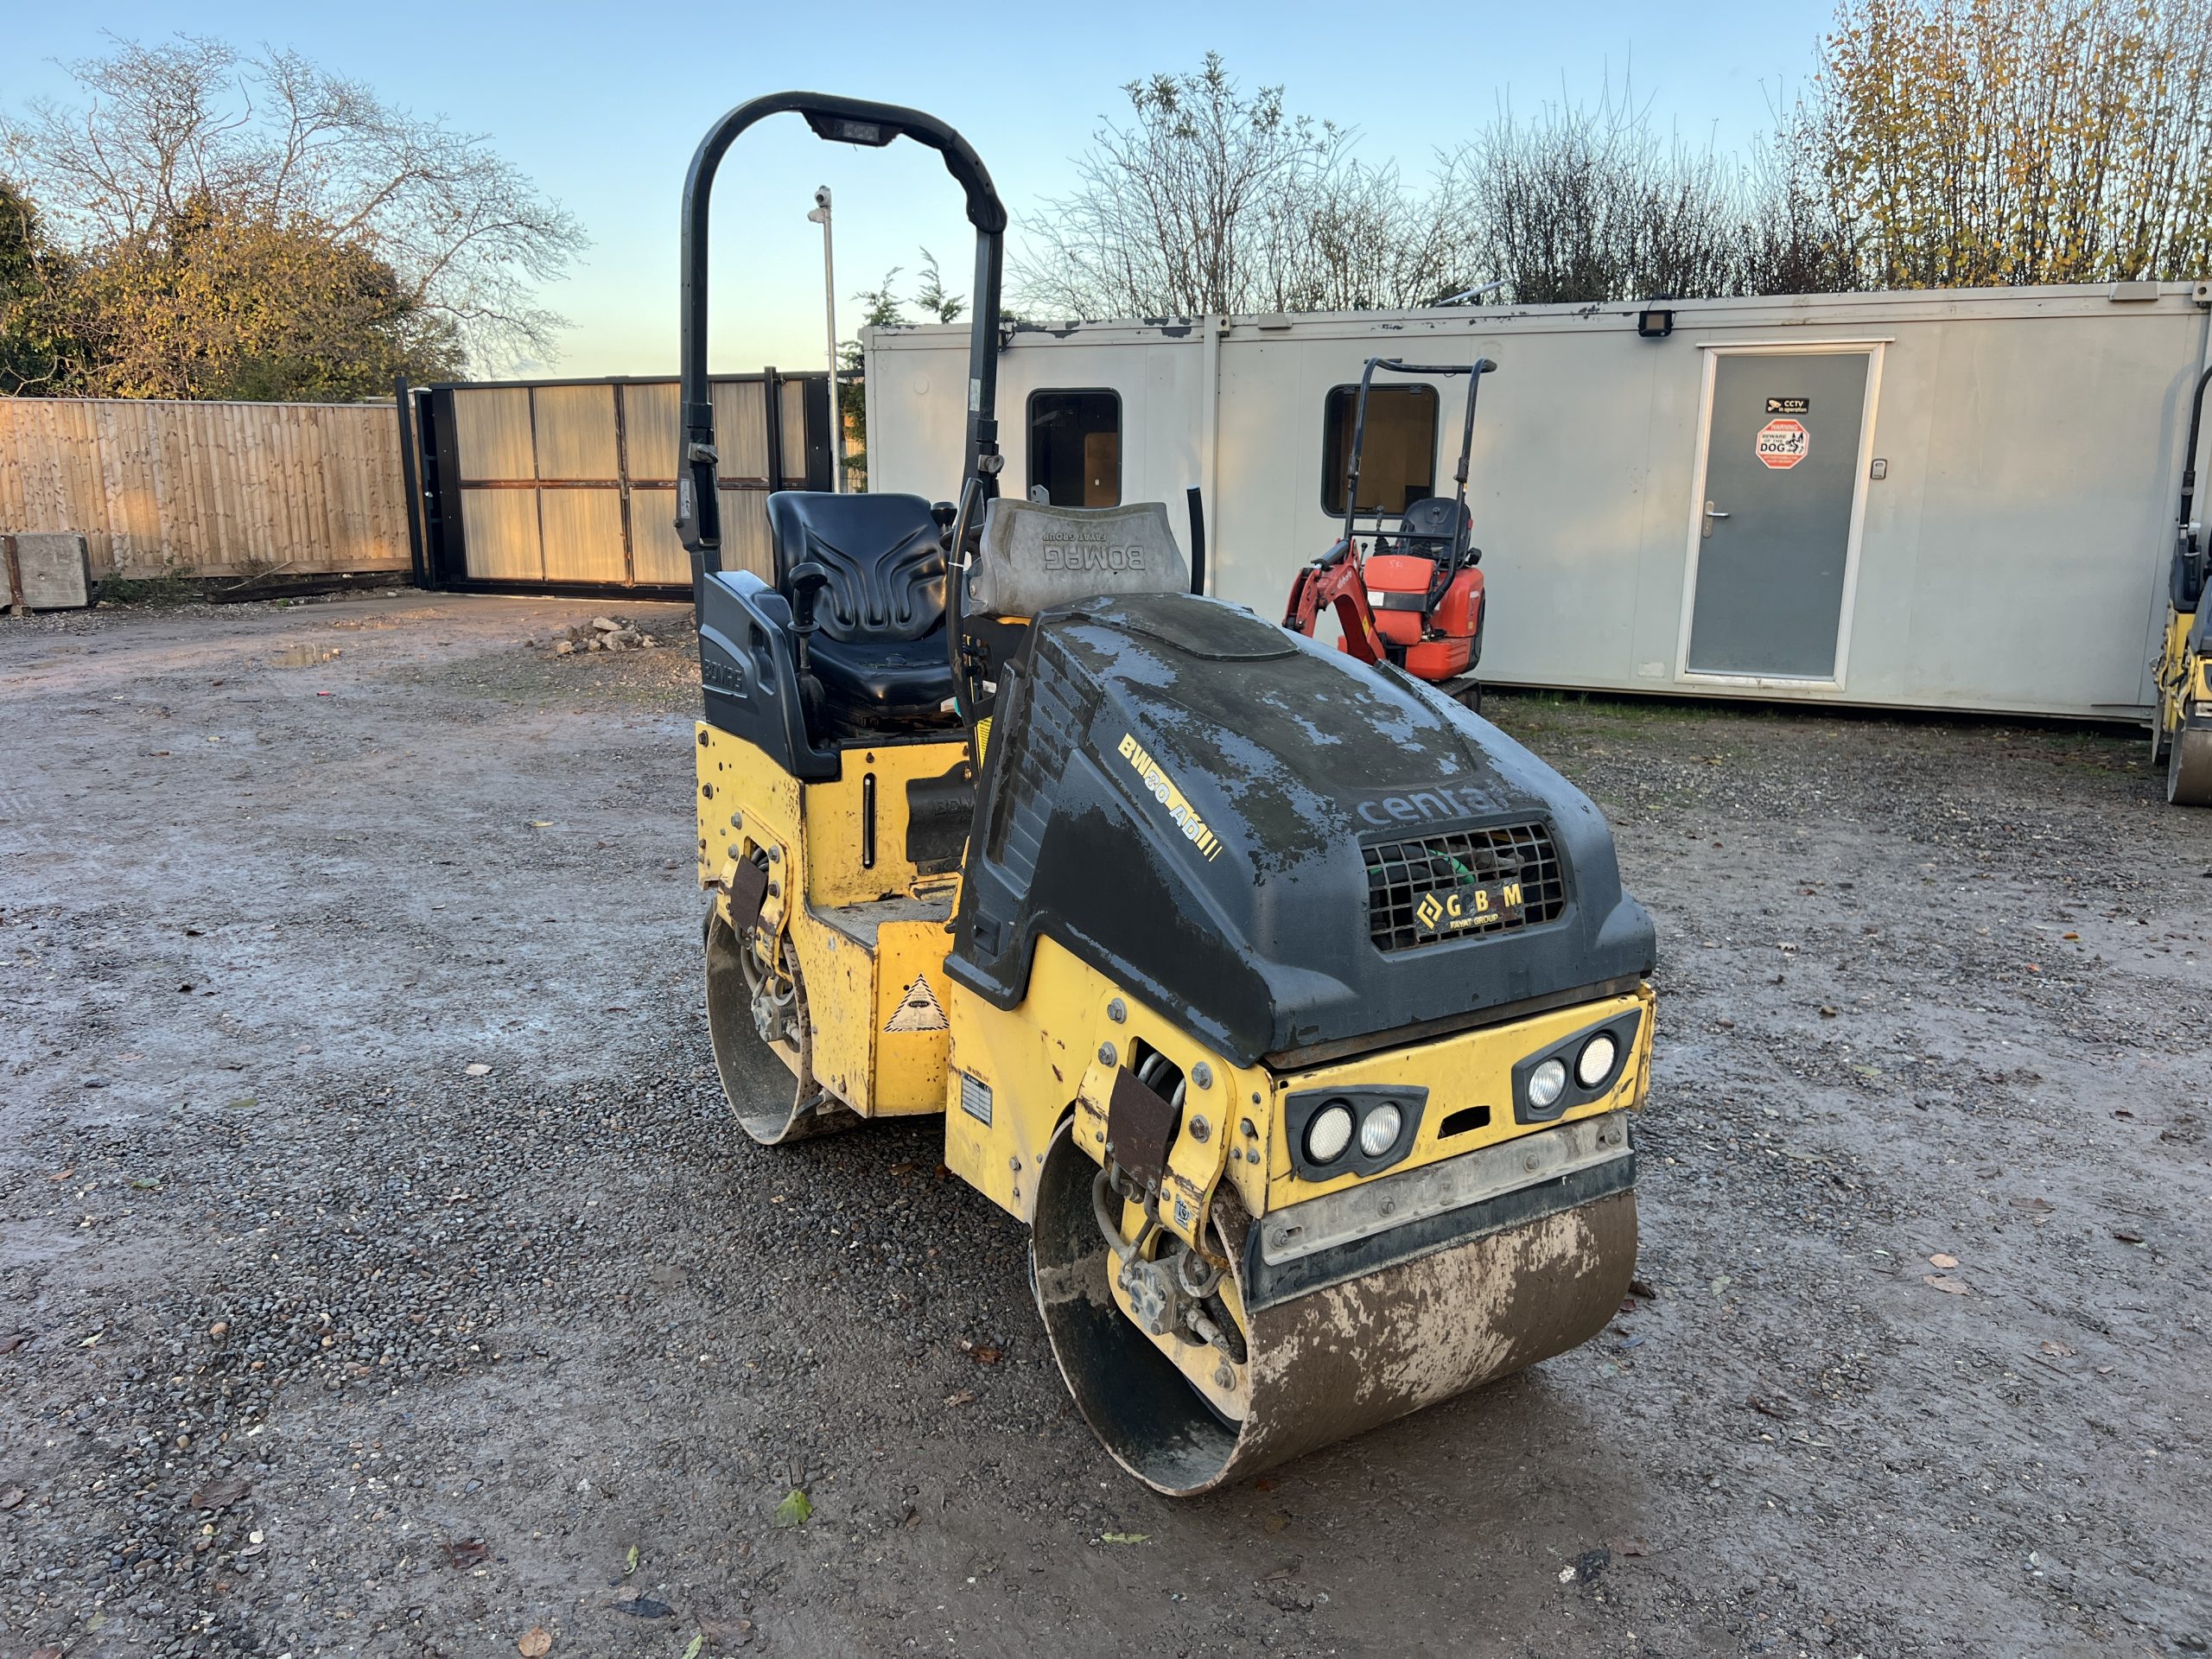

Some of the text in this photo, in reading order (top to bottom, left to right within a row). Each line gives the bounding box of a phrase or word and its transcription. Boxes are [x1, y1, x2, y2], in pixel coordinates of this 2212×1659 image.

[1760, 443, 1785, 452] DOG
[1043, 533, 1107, 542] FAYAT GROUP
[1043, 544, 1147, 571] BOMAG
[704, 658, 742, 692] BOMAG
[1450, 912, 1499, 931] FAYAT GROUP
